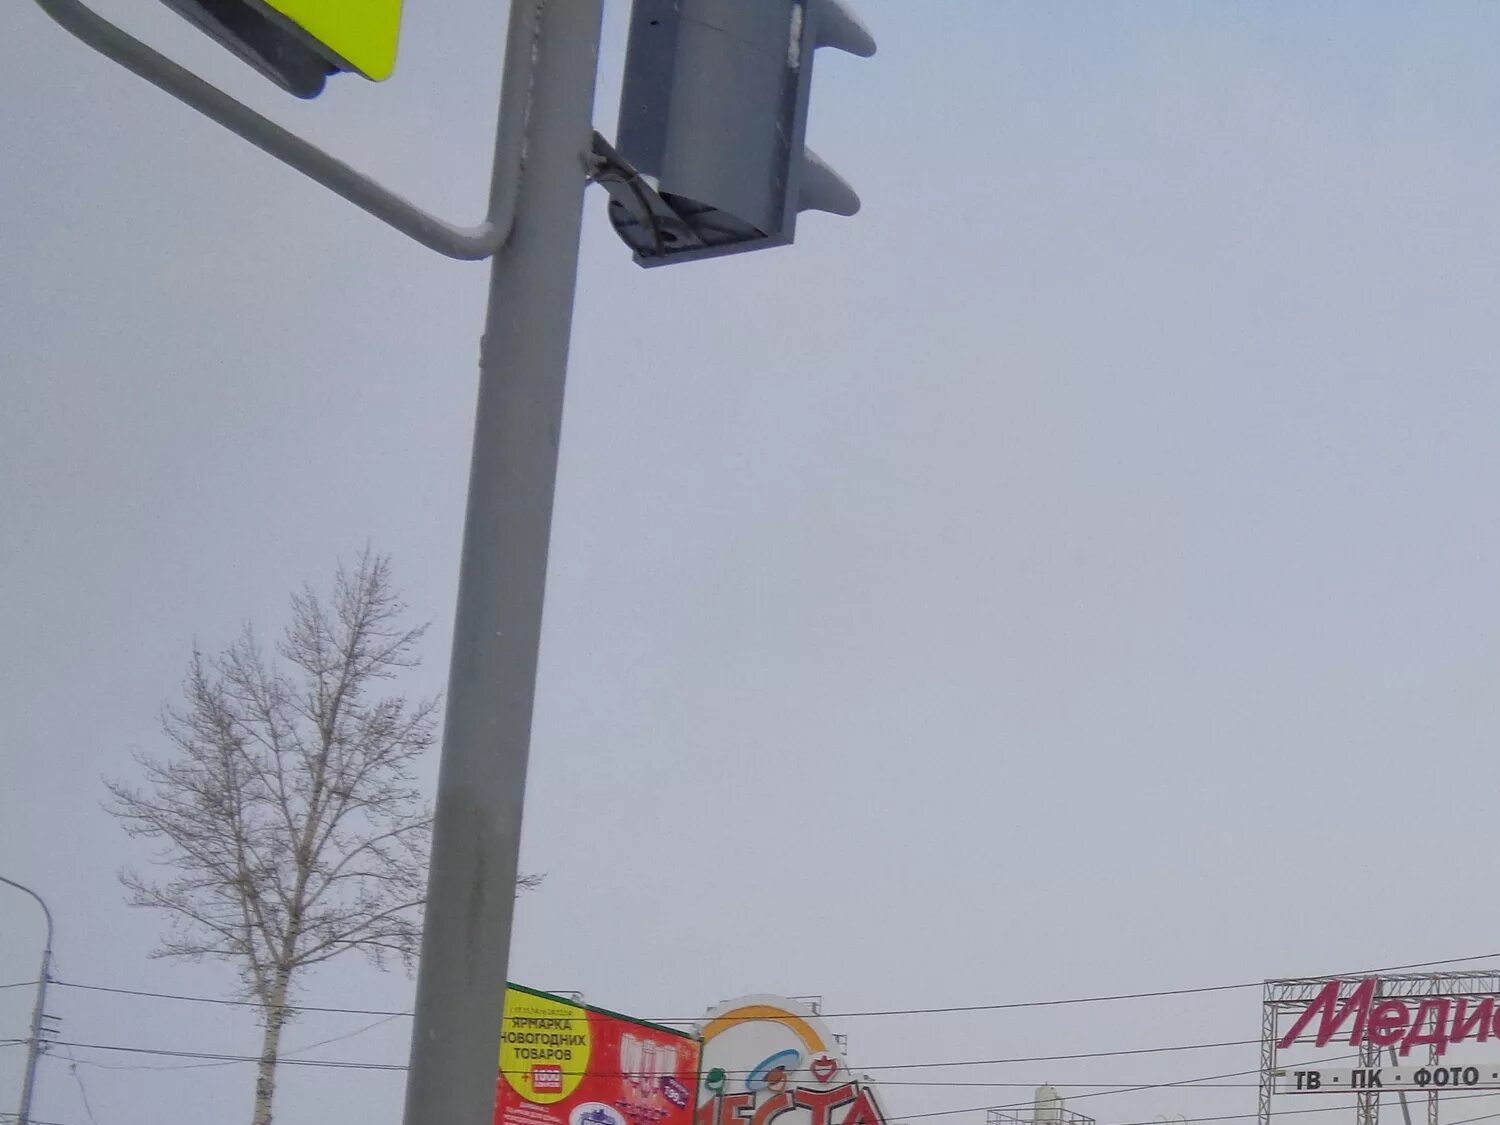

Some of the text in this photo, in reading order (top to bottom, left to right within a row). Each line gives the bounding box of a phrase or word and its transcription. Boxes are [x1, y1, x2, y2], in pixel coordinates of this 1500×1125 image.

[512, 1016, 573, 1031] ЯРМАРКА
[513, 1047, 572, 1061] ТОВАРОВ
[1294, 1071, 1321, 1090] ТВ
[1351, 1069, 1383, 1089] ПК
[1414, 1066, 1480, 1087] ФОТО
